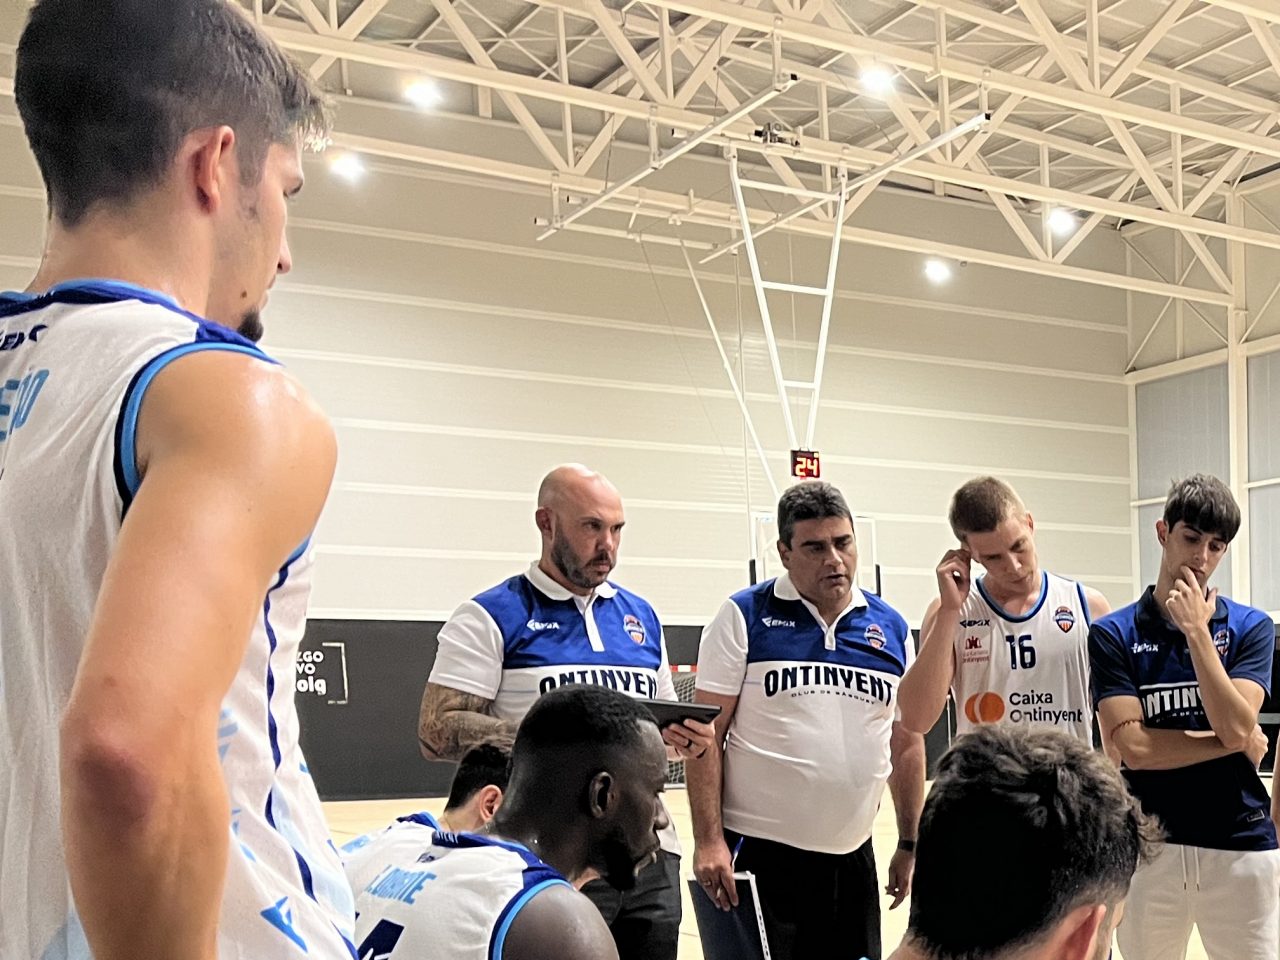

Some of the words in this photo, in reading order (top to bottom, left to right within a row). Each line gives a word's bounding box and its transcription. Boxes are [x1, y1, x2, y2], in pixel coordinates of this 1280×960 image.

[795, 457, 818, 476] 24
[1005, 634, 1037, 670] 16
[764, 665, 893, 707] ONTINYENT
[1009, 689, 1054, 706] Caixa
[1009, 706, 1083, 725] Ontinyent
